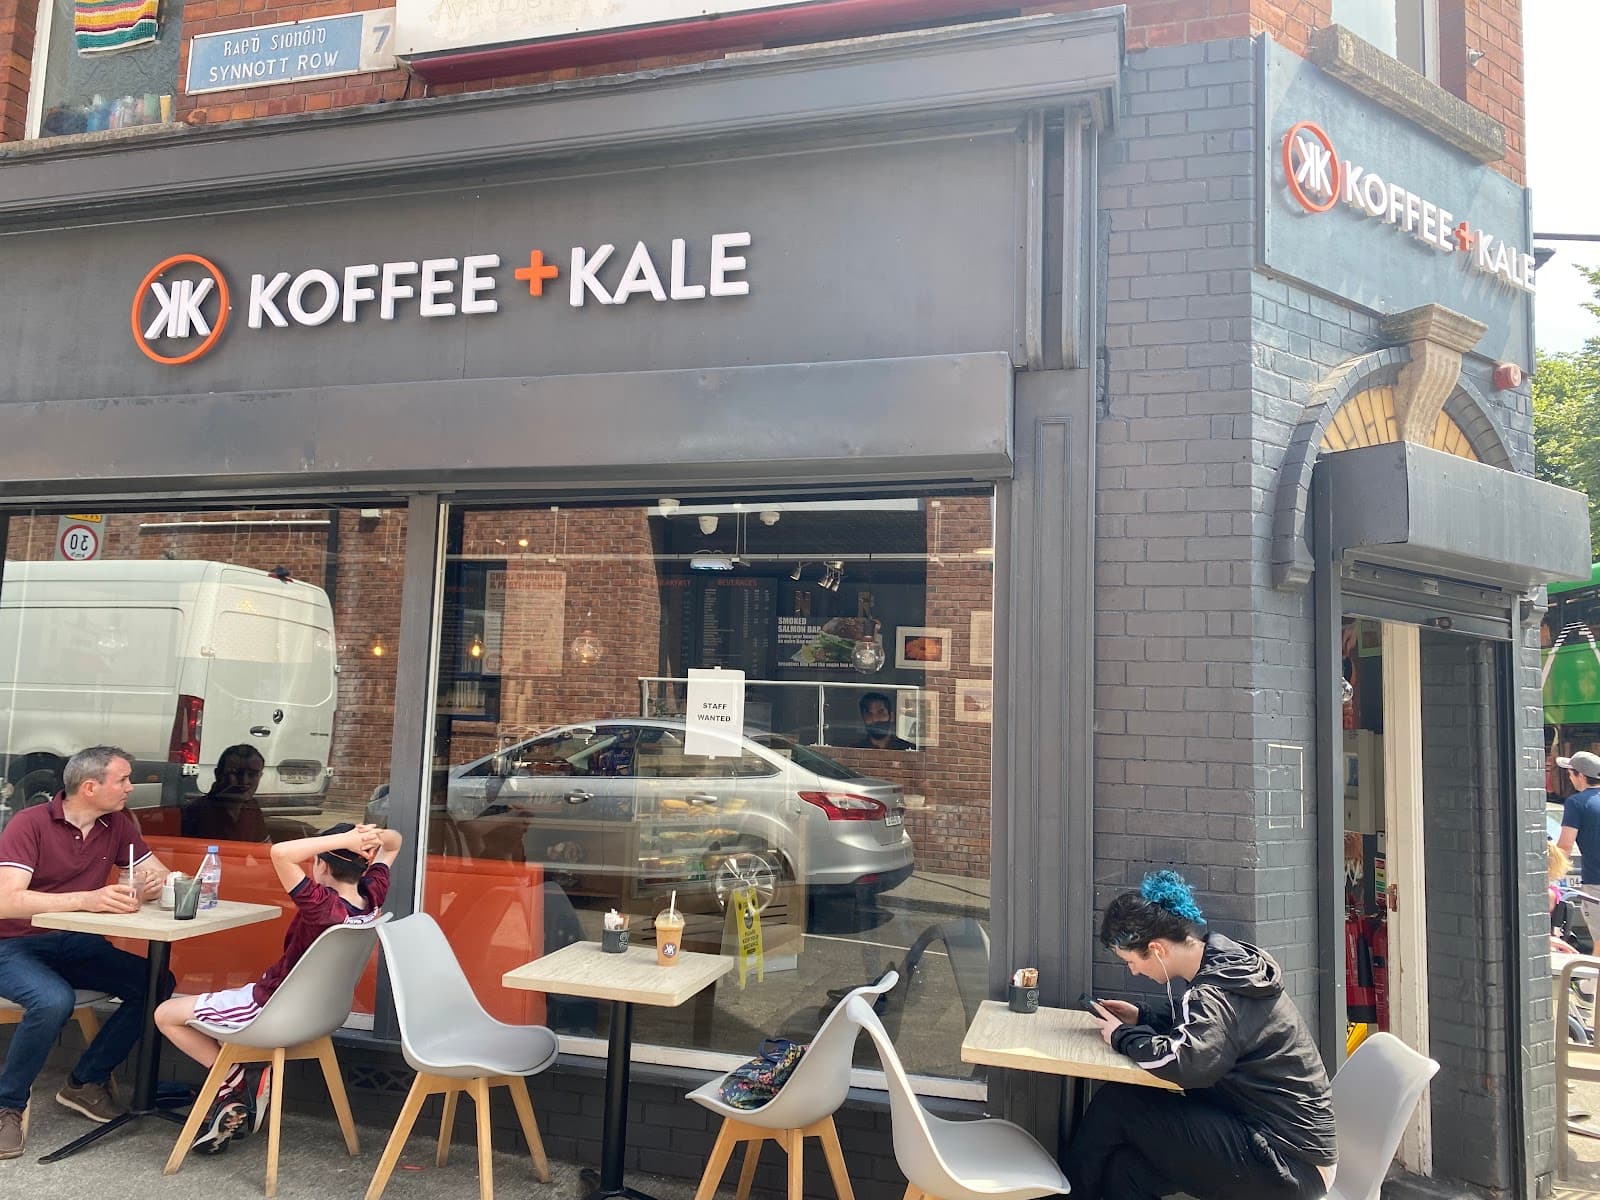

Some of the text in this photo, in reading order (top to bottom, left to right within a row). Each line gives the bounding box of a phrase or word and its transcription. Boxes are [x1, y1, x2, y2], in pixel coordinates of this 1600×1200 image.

[372, 25, 390, 54] 7
[209, 51, 340, 82] SYNNOTT ROW
[1341, 160, 1453, 252] KOFFEE
[1474, 229, 1536, 293] KALE
[248, 254, 500, 328] KOFFEE
[570, 232, 751, 307] KALE
[778, 617, 807, 625] SMOKED
[778, 625, 806, 633] SALMON
[698, 714, 731, 722] WANTED
